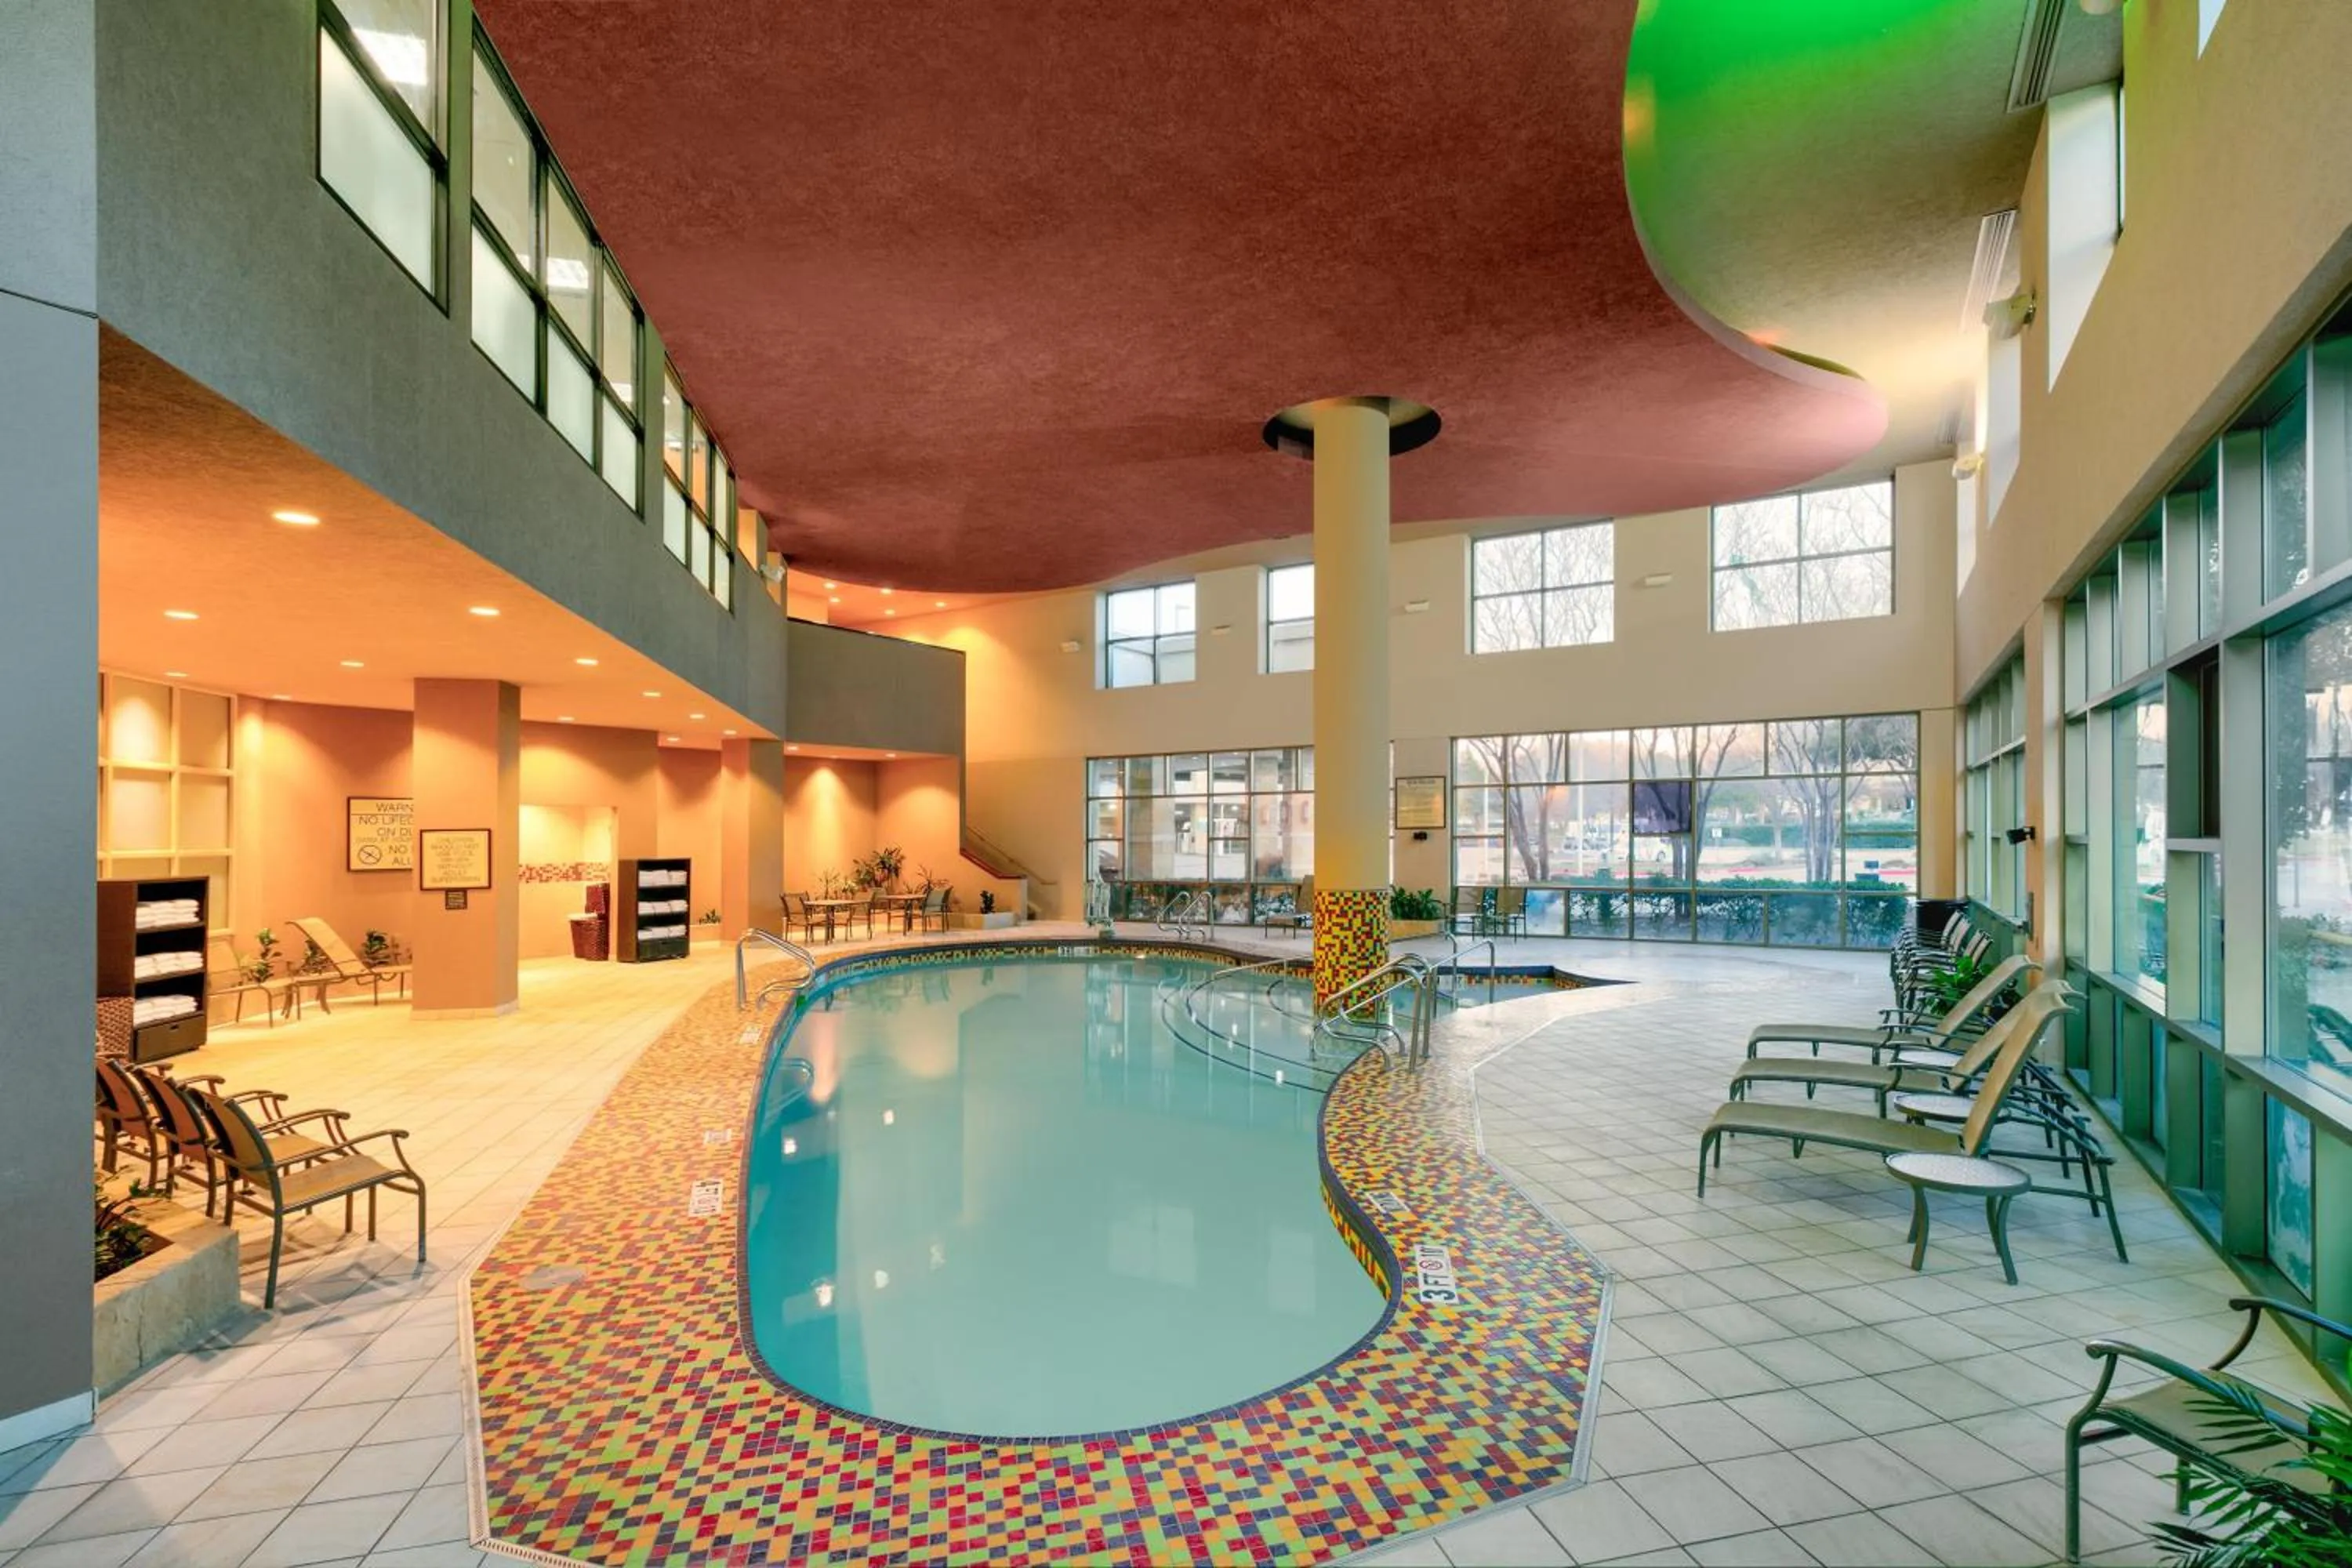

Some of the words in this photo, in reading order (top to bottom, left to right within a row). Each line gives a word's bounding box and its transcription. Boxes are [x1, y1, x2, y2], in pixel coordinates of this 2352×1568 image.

[358, 816, 378, 825] NO
[377, 827, 396, 837] ON
[388, 844, 408, 854] NO
[1423, 1273, 1451, 1287] FT
[1422, 1290, 1456, 1301] 3
